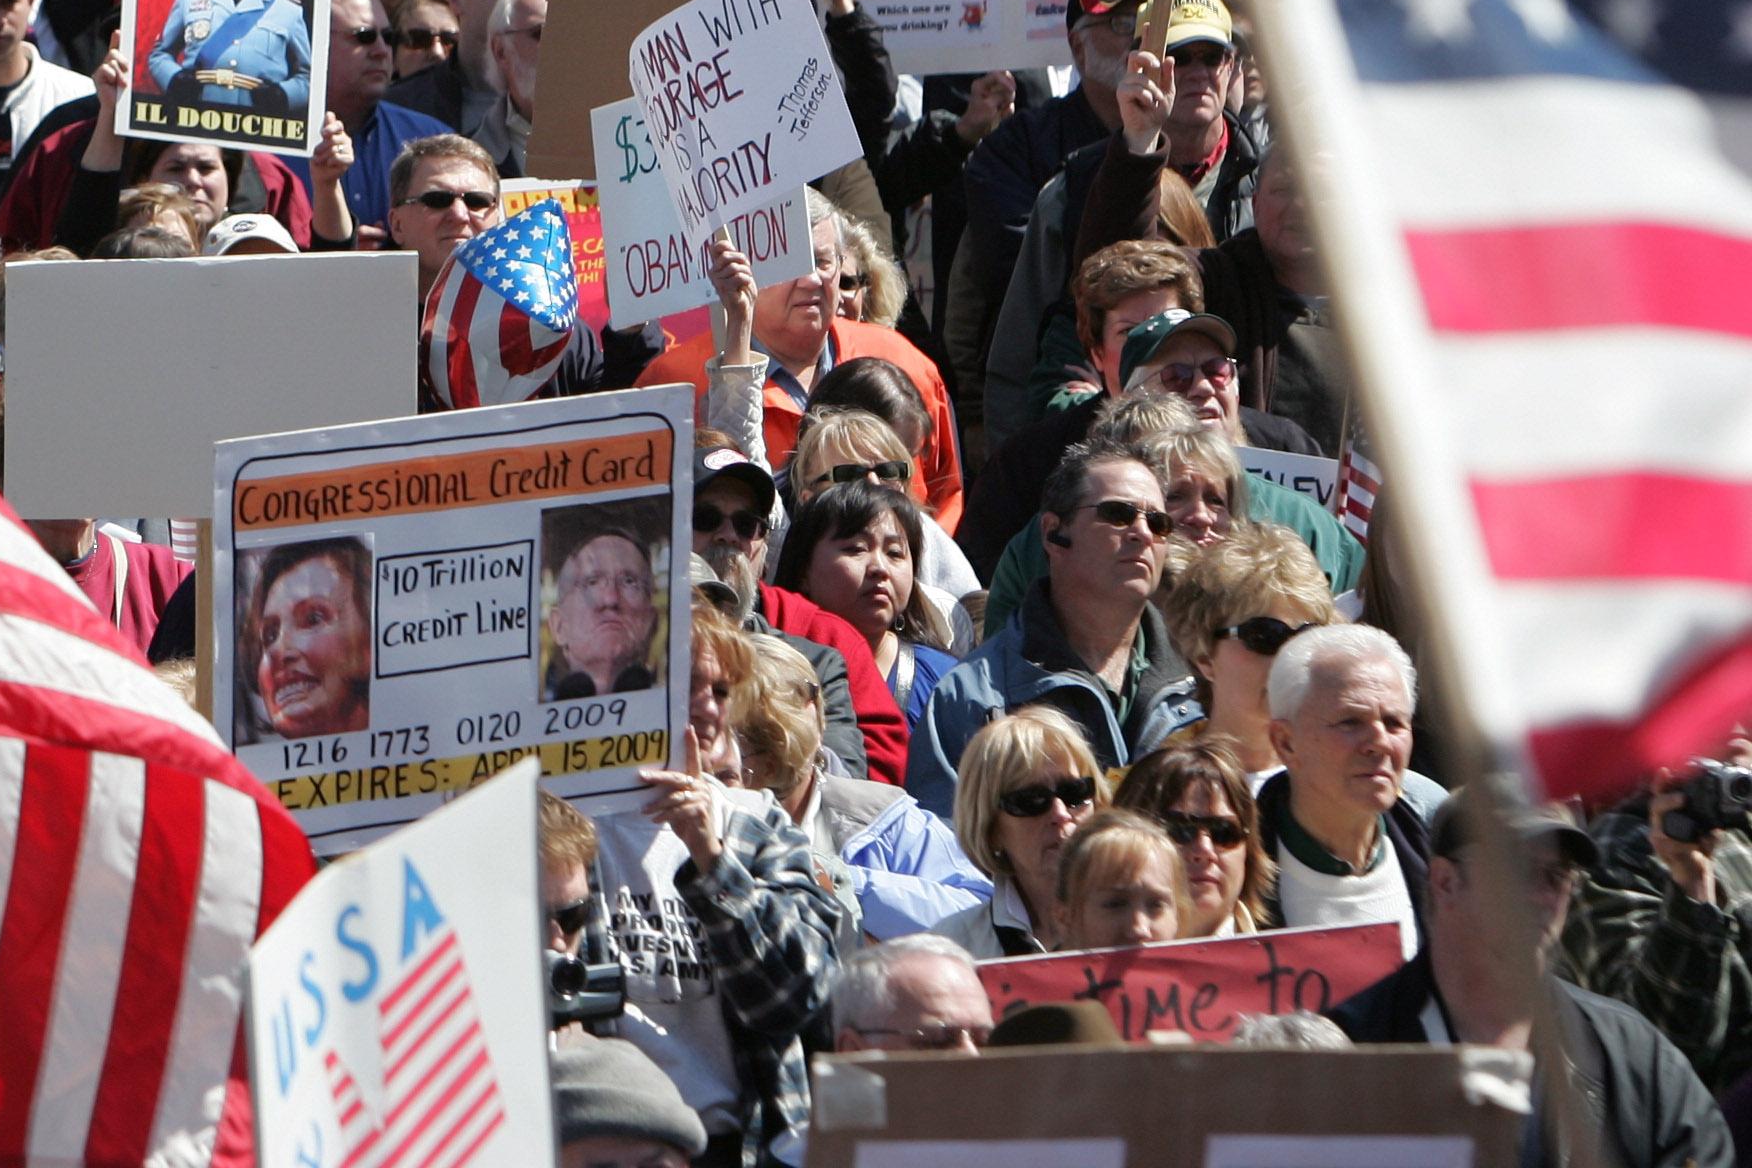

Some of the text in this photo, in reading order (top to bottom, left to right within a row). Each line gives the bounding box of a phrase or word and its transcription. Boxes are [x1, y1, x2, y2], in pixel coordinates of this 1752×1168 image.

[876, 4, 910, 17] Which
[901, 20, 950, 33] drinking?
[639, 22, 693, 91] MAN
[134, 101, 306, 142] IL DOUCHE
[698, 117, 719, 158] A
[788, 72, 832, 144] Jefferson
[489, 449, 571, 499] Credit
[581, 438, 656, 487] Card
[277, 728, 668, 809] EXPIRES: 2009
[283, 698, 628, 772] 1216 1773 0120 2009
[268, 854, 447, 1099] USSA
[1255, 942, 1332, 1015] to
